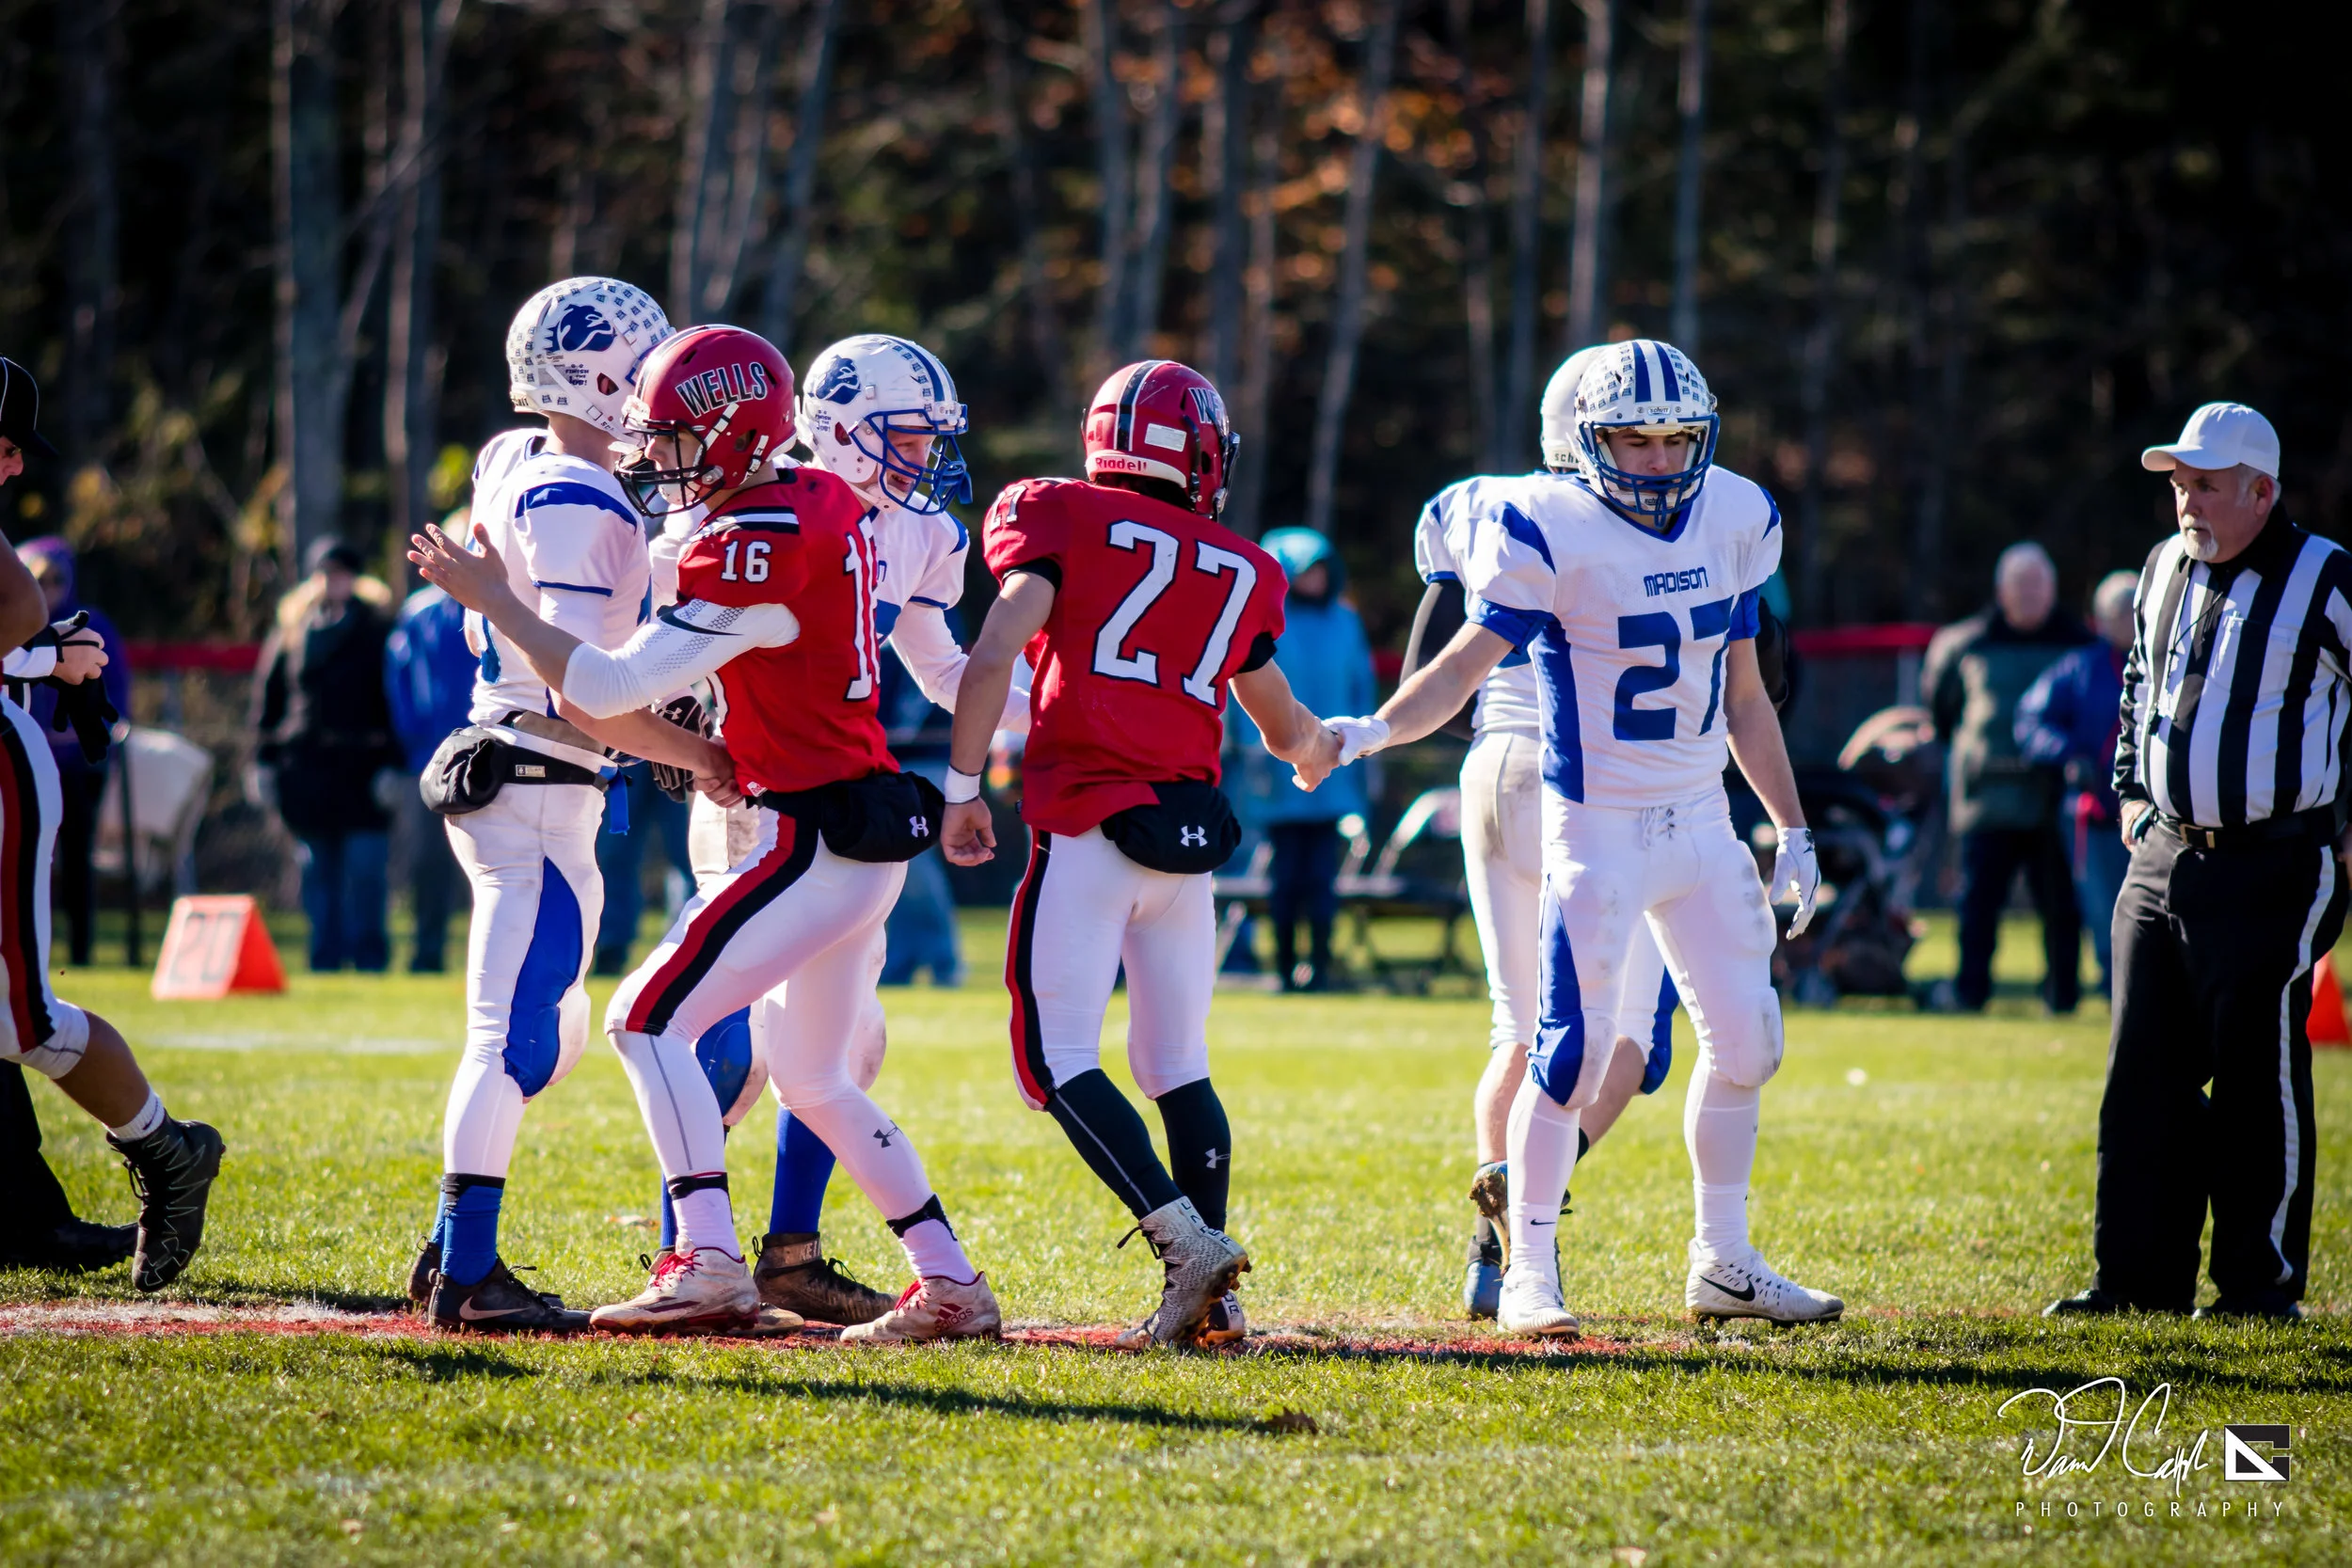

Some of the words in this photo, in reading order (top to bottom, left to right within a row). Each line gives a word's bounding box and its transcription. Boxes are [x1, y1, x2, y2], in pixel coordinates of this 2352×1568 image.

[675, 361, 768, 419] WELLS
[990, 484, 1028, 533] 27
[720, 539, 771, 584] 16
[1644, 566, 1708, 597] MADISON
[1091, 519, 1257, 707] 27
[1613, 594, 1735, 741] 27
